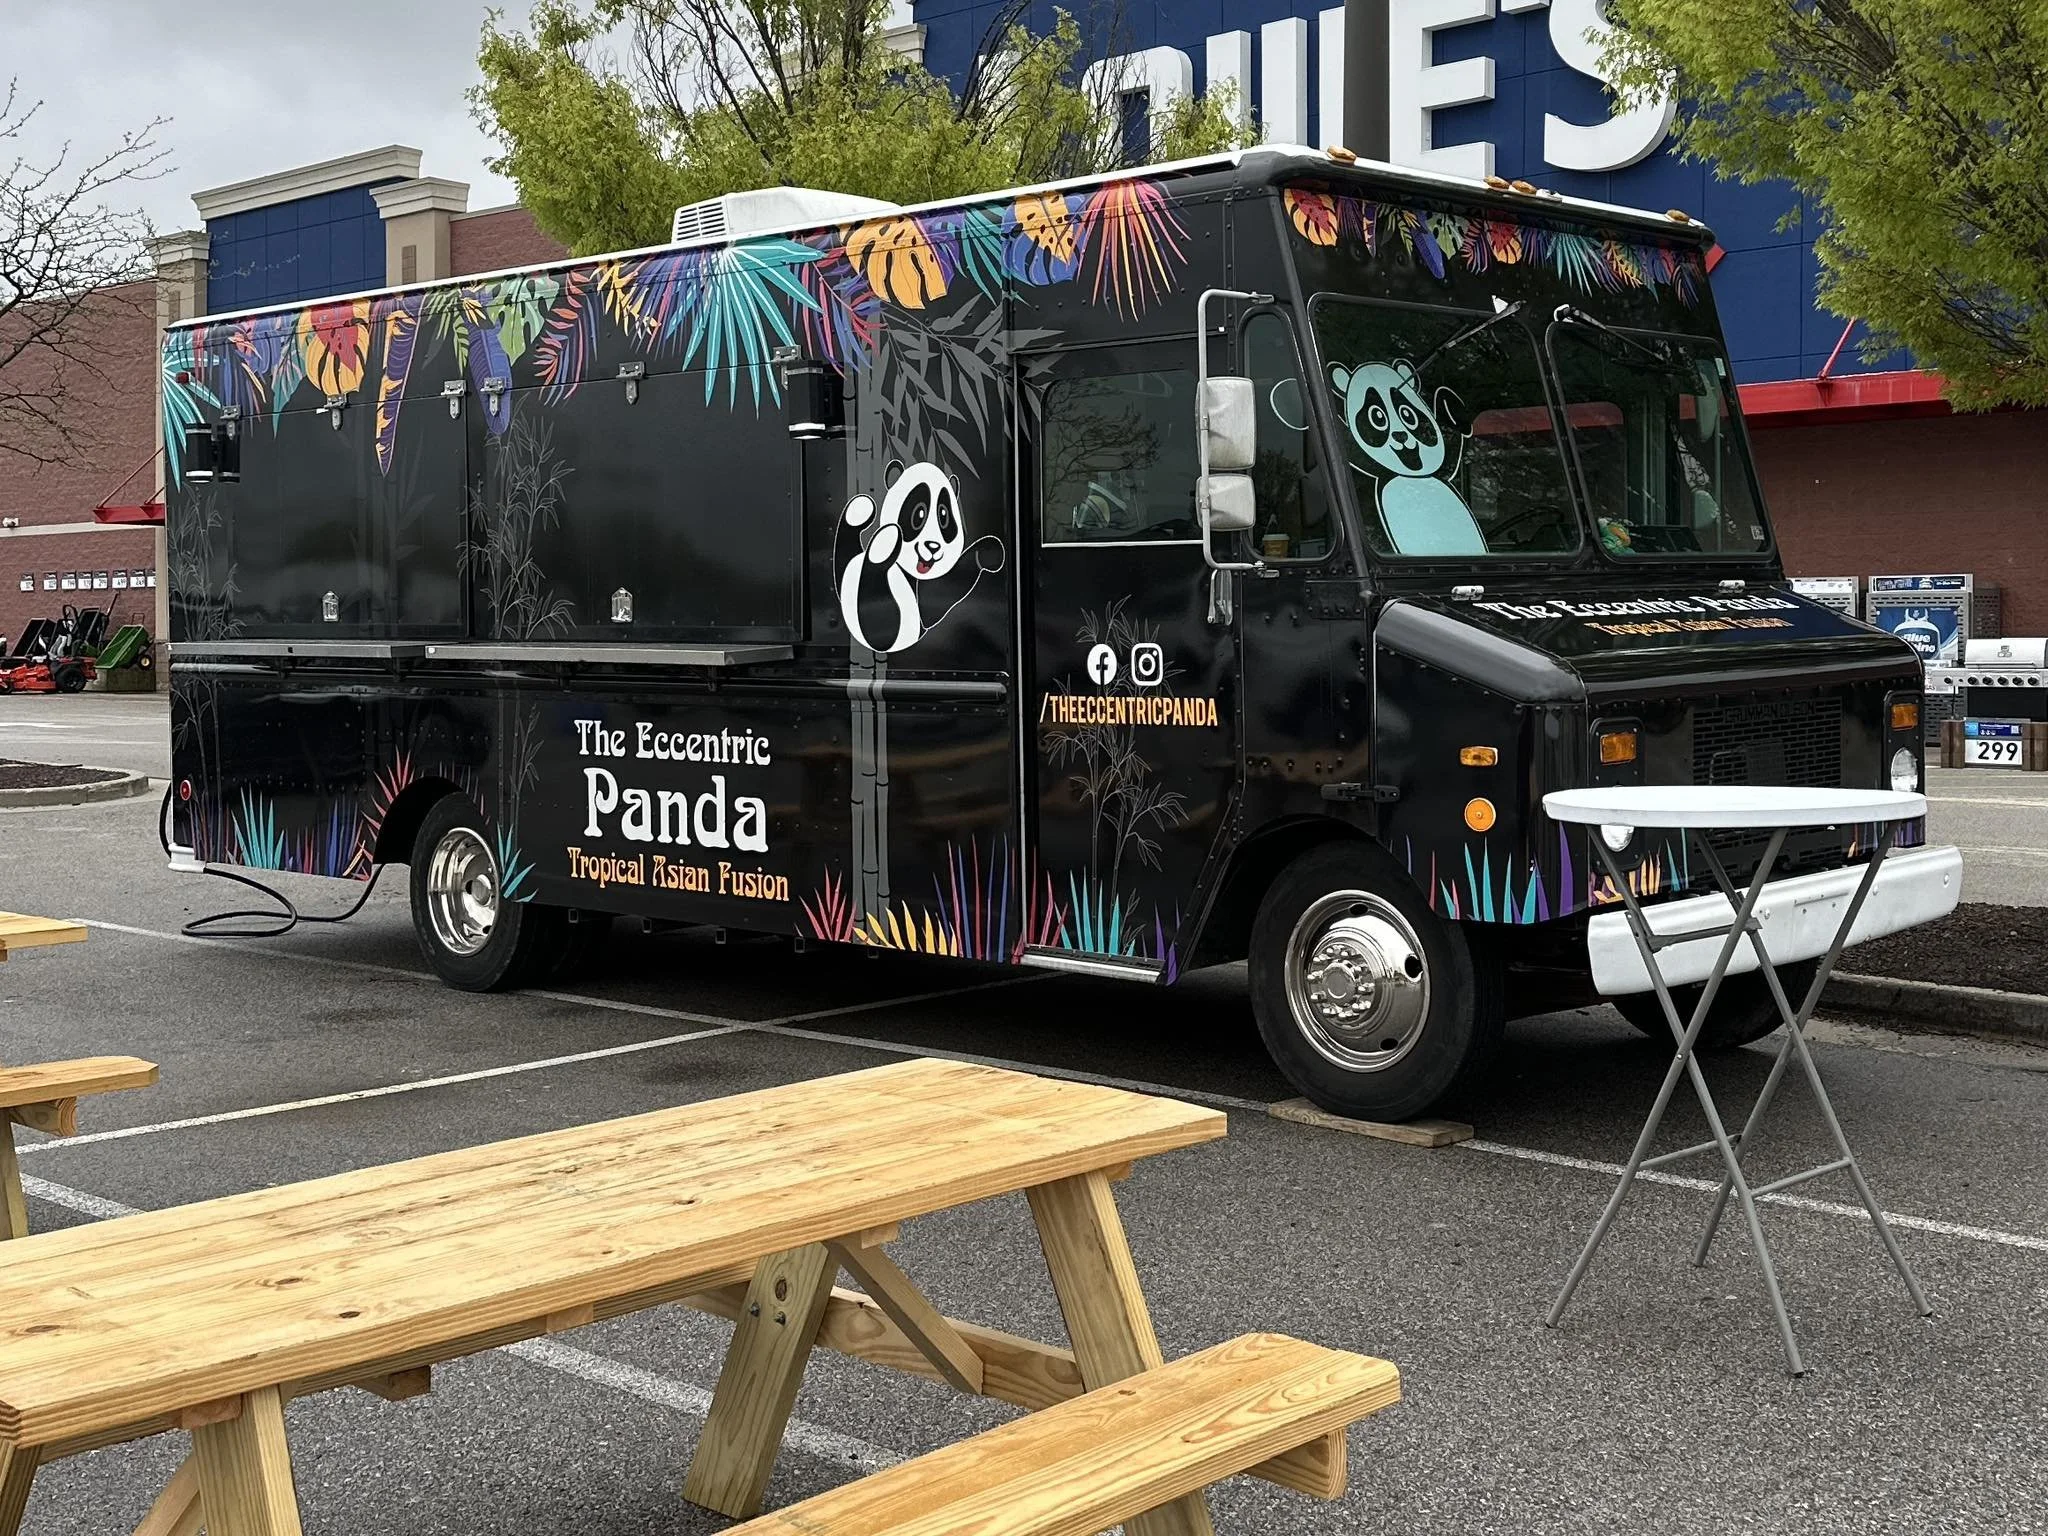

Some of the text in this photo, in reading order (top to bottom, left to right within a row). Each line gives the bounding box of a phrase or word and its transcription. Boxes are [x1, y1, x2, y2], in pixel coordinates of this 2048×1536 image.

[1472, 595, 1800, 620] The Eccentric Panda
[1584, 618, 1681, 637] Tropical
[1039, 692, 1218, 726] /THEECCENTRICPANDA
[574, 719, 771, 766] The Eccentric
[1978, 741, 2018, 761] 299
[583, 767, 769, 853] Panda
[567, 846, 790, 901] Tropical Asian Fusion
